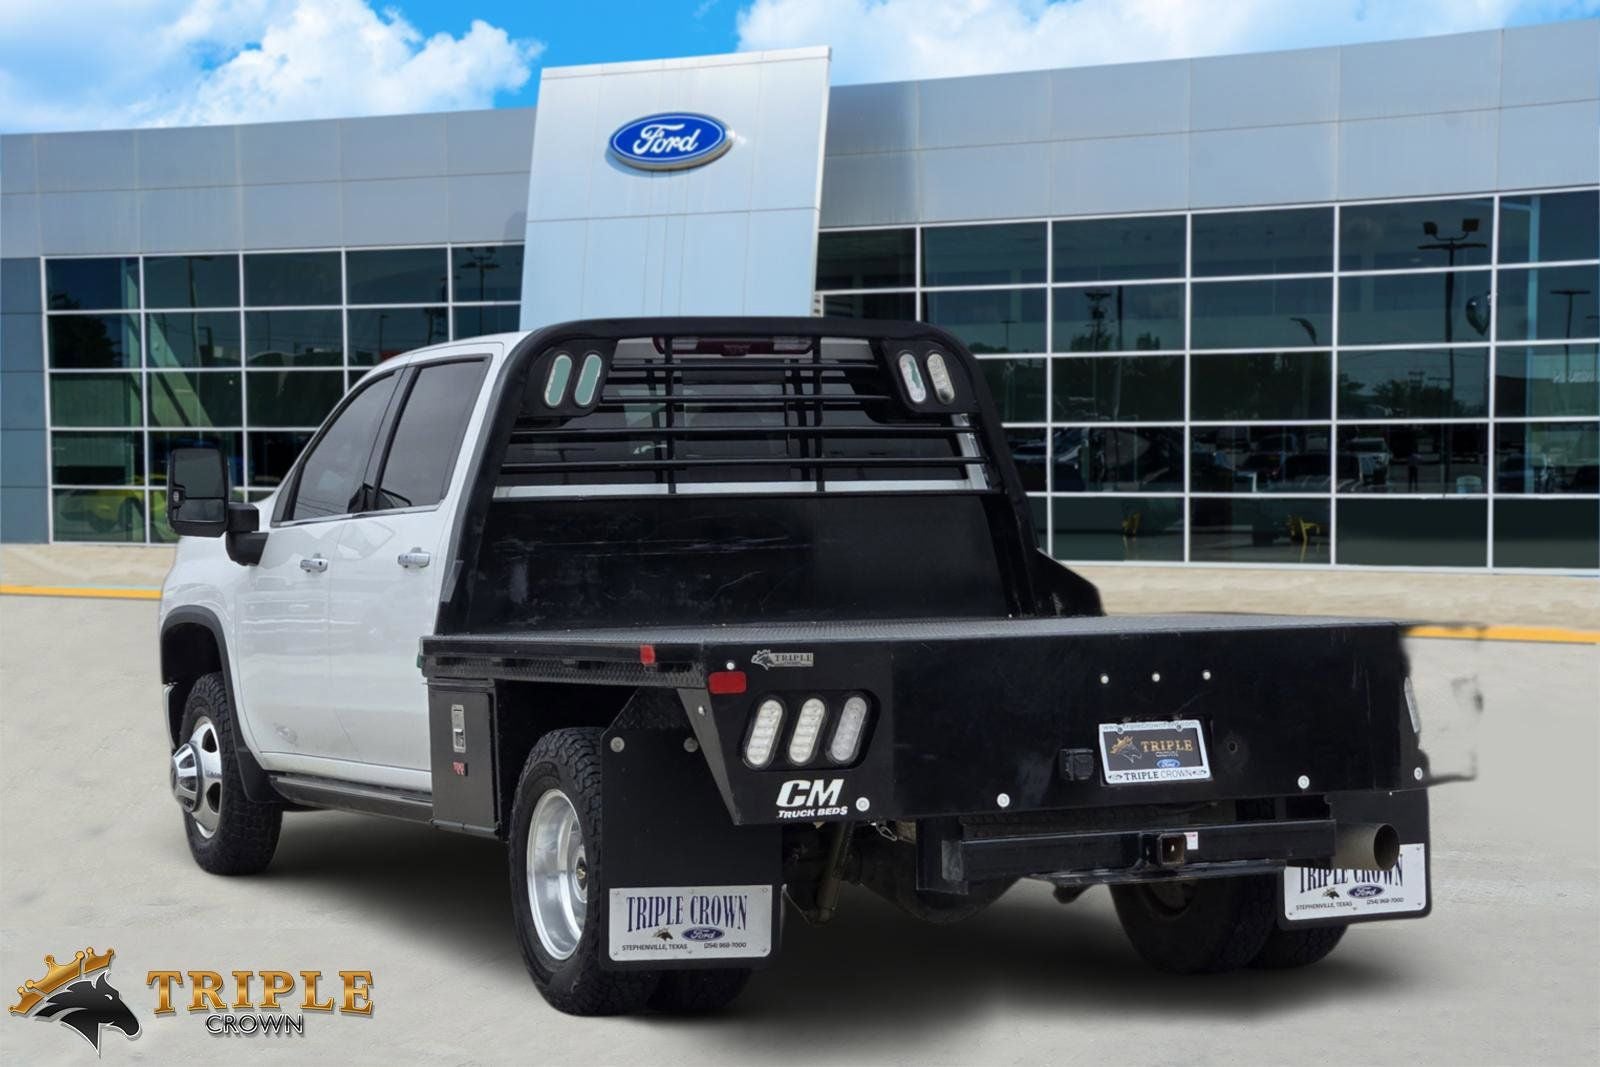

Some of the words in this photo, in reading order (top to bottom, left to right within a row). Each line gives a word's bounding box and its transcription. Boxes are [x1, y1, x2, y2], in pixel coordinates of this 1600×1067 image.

[632, 123, 702, 155] Ford
[1140, 739, 1193, 753] TRIPLE
[1123, 771, 1160, 781] TRIPLE
[1160, 769, 1193, 779] CROWN
[775, 778, 845, 808] CM
[777, 808, 817, 819] TRUCK
[817, 806, 849, 816] BEDS
[1354, 886, 1378, 897] Ford
[626, 895, 684, 932] TRIPLE
[690, 895, 748, 930] CROWN
[689, 929, 717, 940] Ford
[622, 943, 668, 951] STEPHENVILLE,
